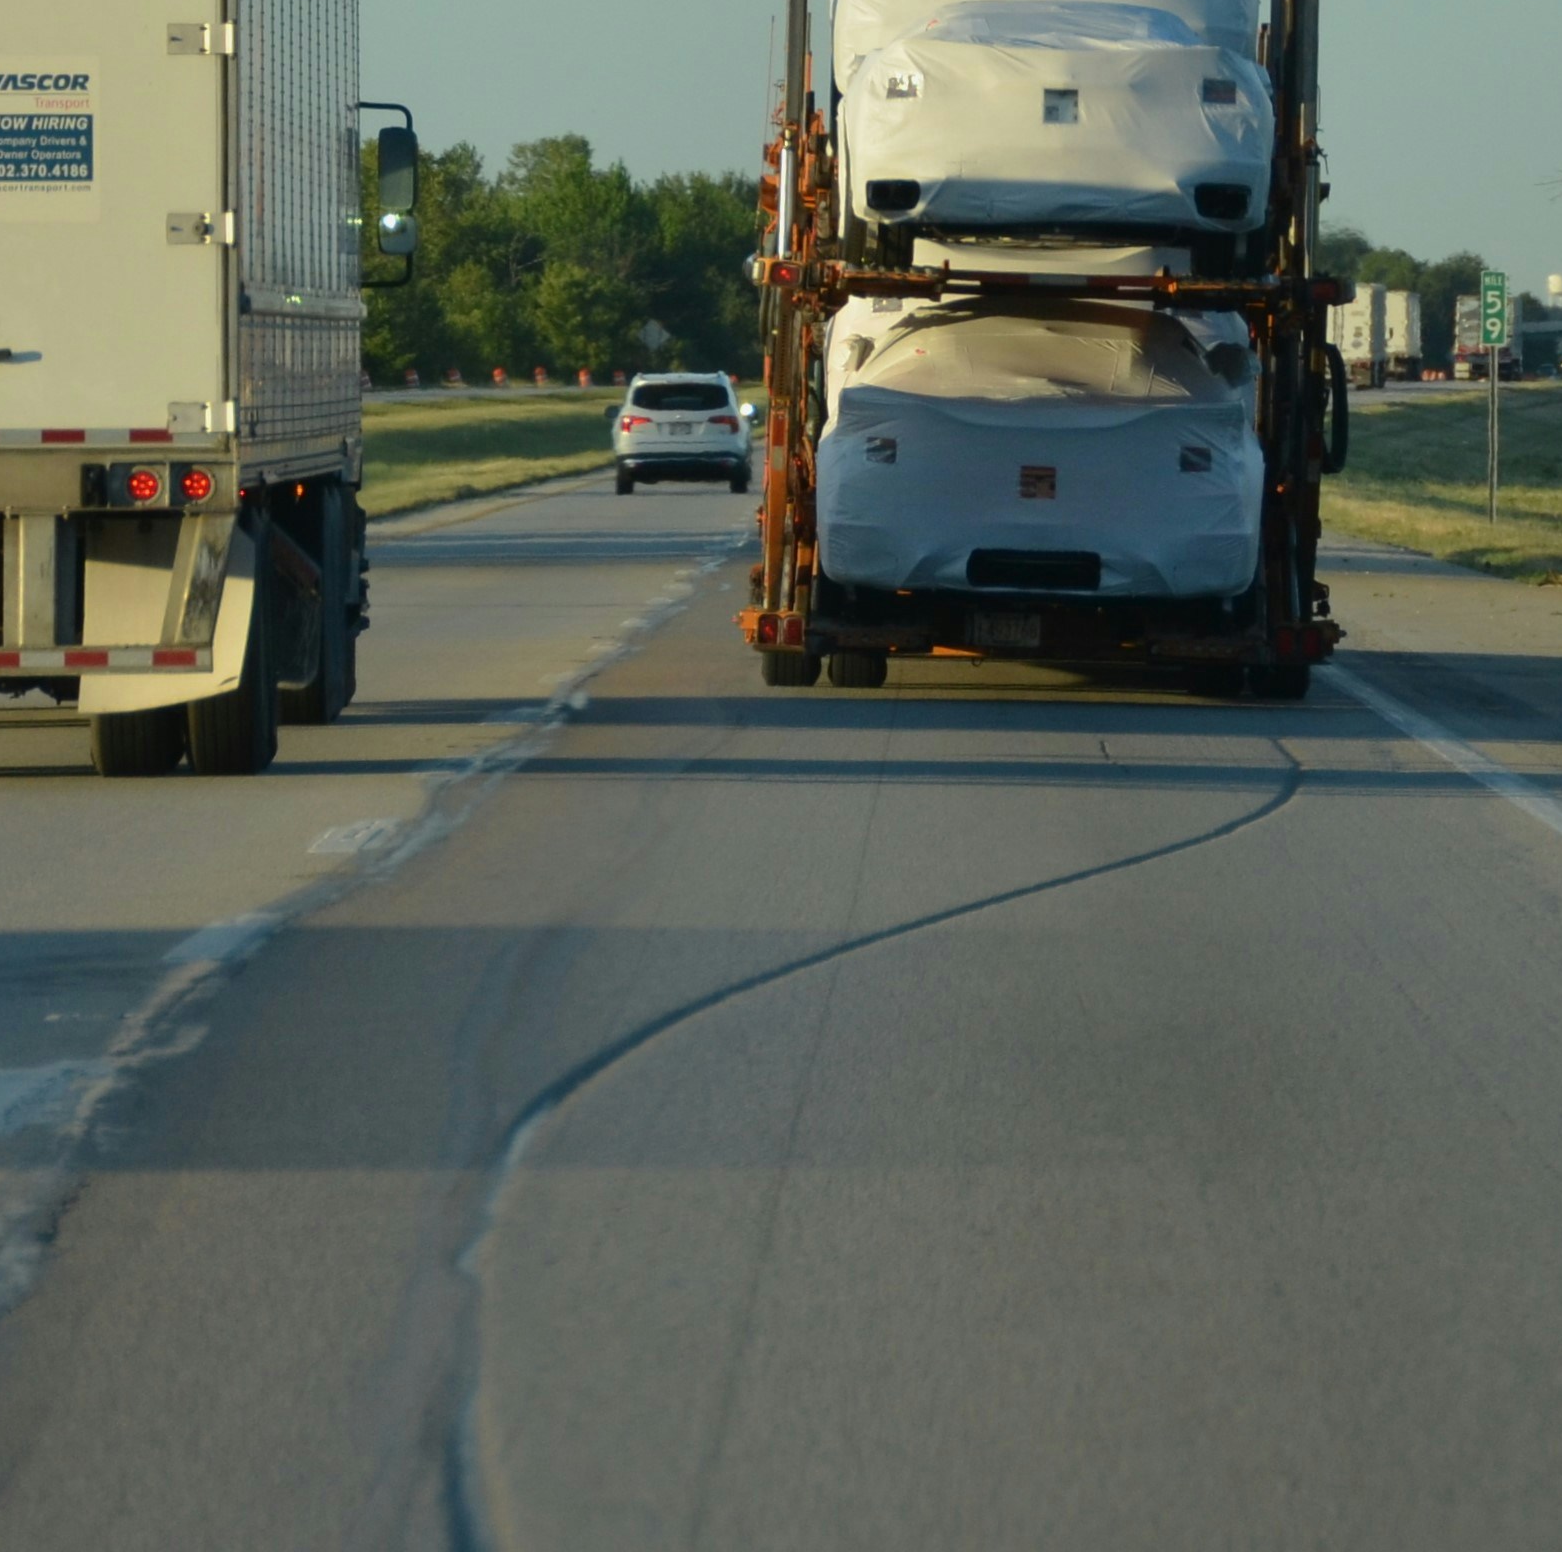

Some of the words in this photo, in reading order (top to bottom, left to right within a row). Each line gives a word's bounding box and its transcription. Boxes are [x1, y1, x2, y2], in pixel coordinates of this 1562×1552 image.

[34, 97, 91, 110] Transport
[31, 116, 89, 131] HIRING
[39, 135, 77, 146] Drivers
[79, 135, 87, 146] &
[30, 149, 82, 161] Operators
[1484, 275, 1503, 286] MILE
